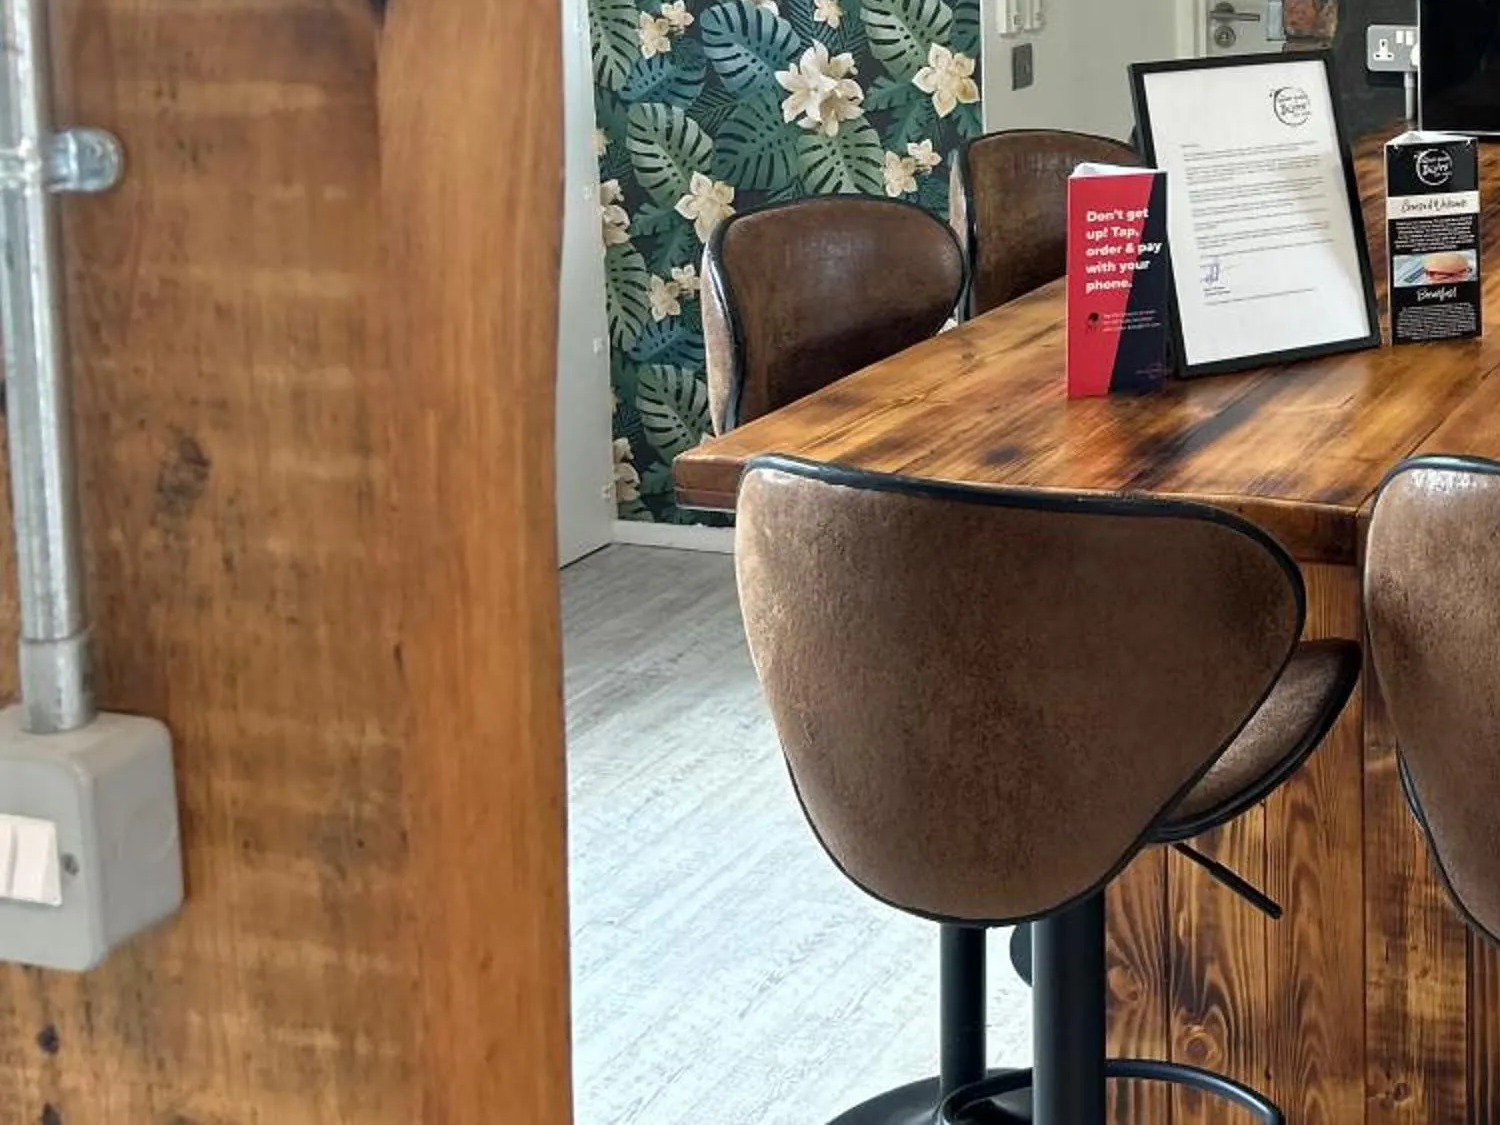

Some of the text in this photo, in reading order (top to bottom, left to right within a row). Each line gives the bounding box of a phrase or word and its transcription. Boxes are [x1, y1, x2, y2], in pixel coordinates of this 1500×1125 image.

[1087, 207, 1149, 222] Don't get
[1086, 227, 1109, 241] up!
[1086, 242, 1162, 256] order & pay
[1086, 260, 1150, 274] with your
[1086, 279, 1133, 294] phone.
